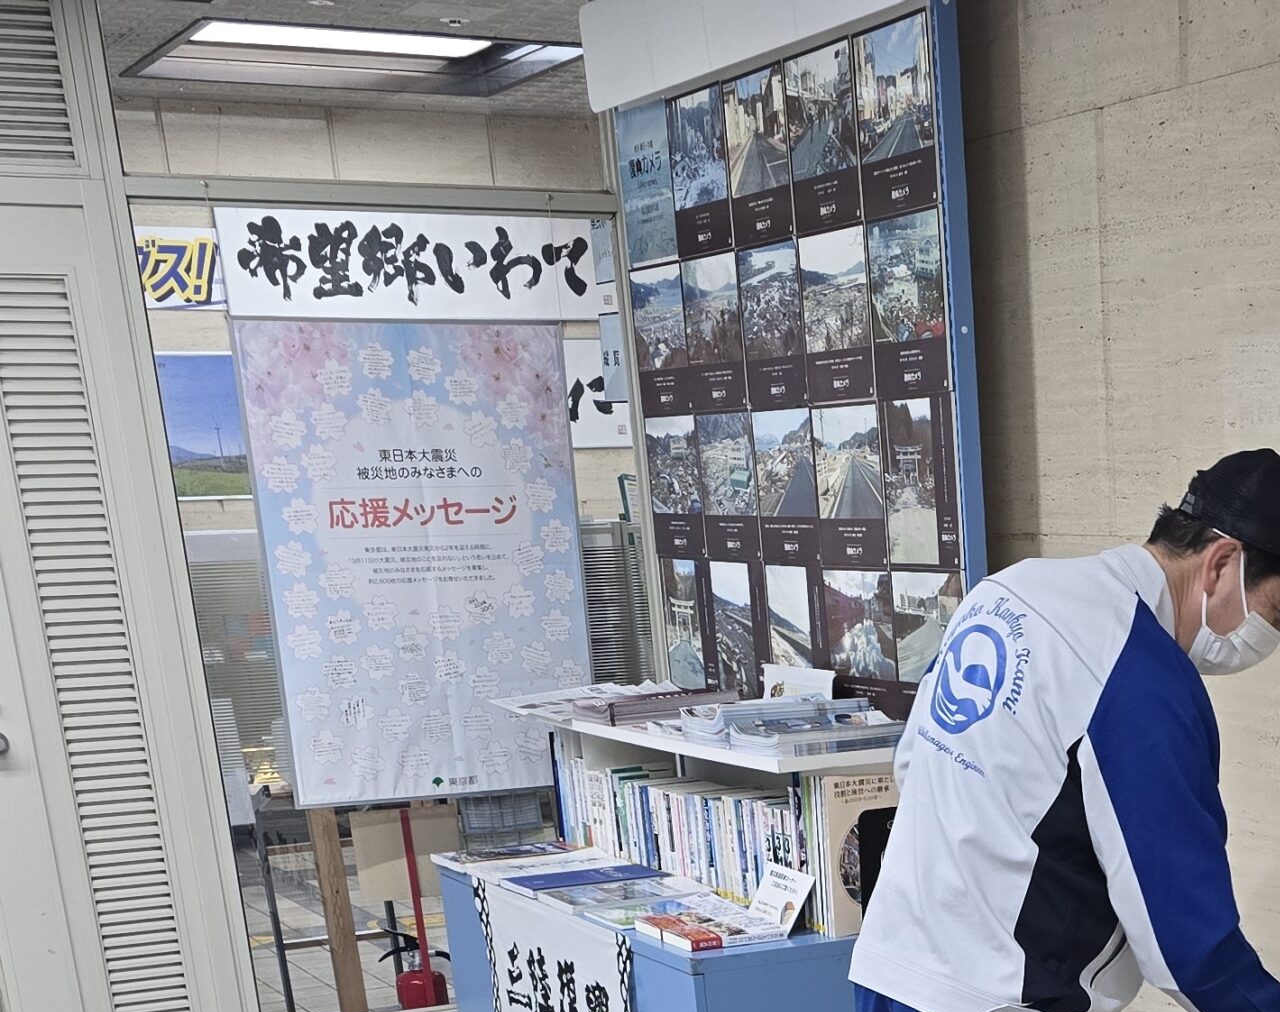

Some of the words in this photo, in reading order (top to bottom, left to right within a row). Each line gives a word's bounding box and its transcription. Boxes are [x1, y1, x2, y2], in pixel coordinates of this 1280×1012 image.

[237, 215, 588, 306] 希望郷いわて
[379, 448, 458, 463] 東日本大震災
[356, 466, 483, 480] 被災地のみなさまへの
[328, 494, 517, 529] 応援メッセージ
[448, 775, 478, 786] 東京都
